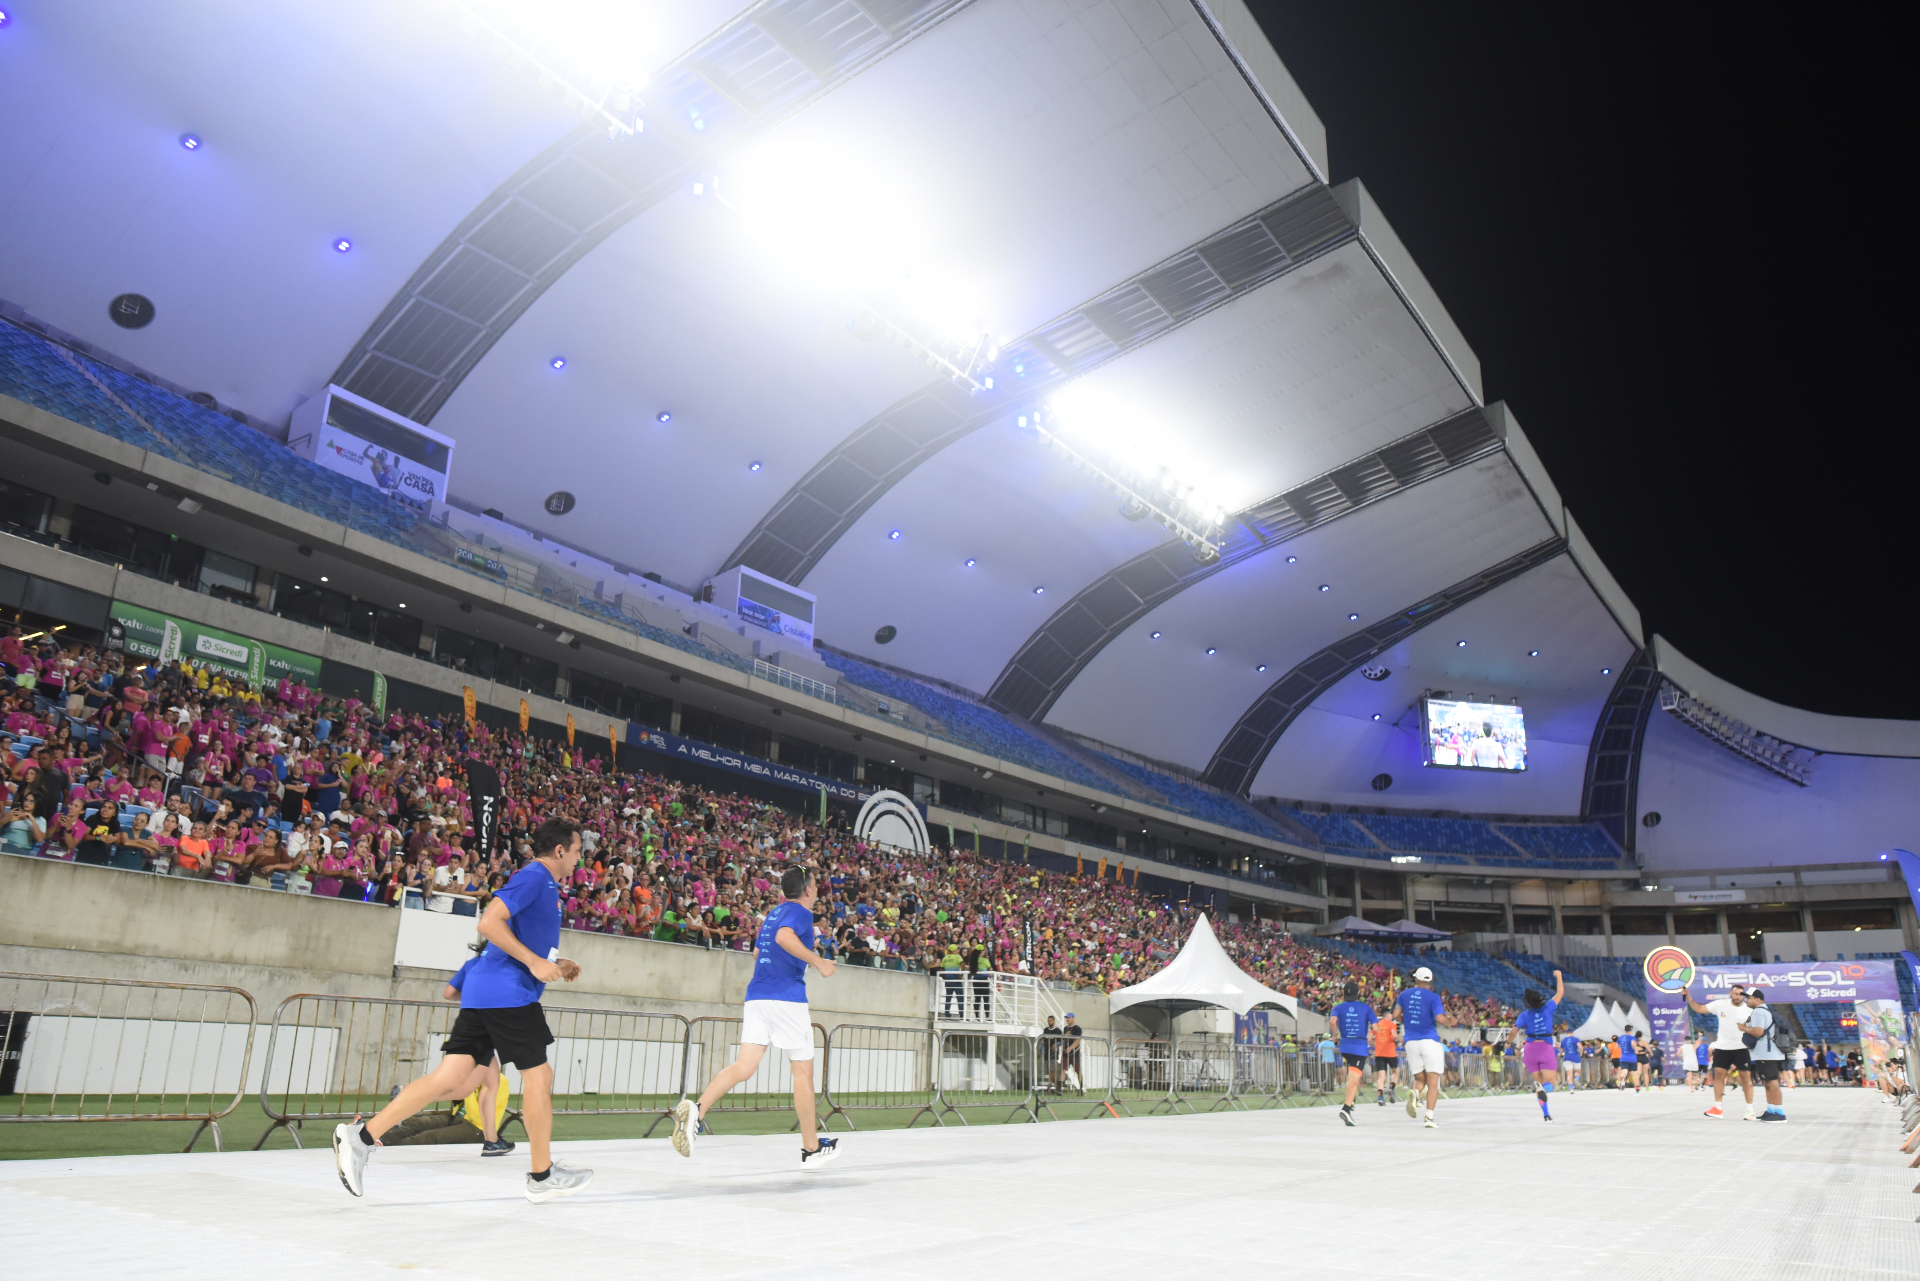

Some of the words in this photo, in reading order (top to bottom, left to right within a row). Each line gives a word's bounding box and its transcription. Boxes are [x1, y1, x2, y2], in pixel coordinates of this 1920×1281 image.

[404, 476, 435, 496] CASA
[164, 625, 178, 660] Sicredi
[213, 643, 243, 658] Sicredi
[129, 642, 138, 651] O
[138, 644, 160, 657] SEU
[261, 677, 277, 689] STÁ
[250, 646, 261, 681] Sicredi
[677, 744, 688, 754] A
[691, 747, 741, 768] MELHOR
[744, 761, 771, 776] MEIA
[774, 769, 838, 794] MARATONA
[840, 788, 856, 798] DO
[1787, 970, 1855, 986] SOL
[1840, 965, 1865, 977] 10
[1820, 988, 1856, 997] Sicredi
